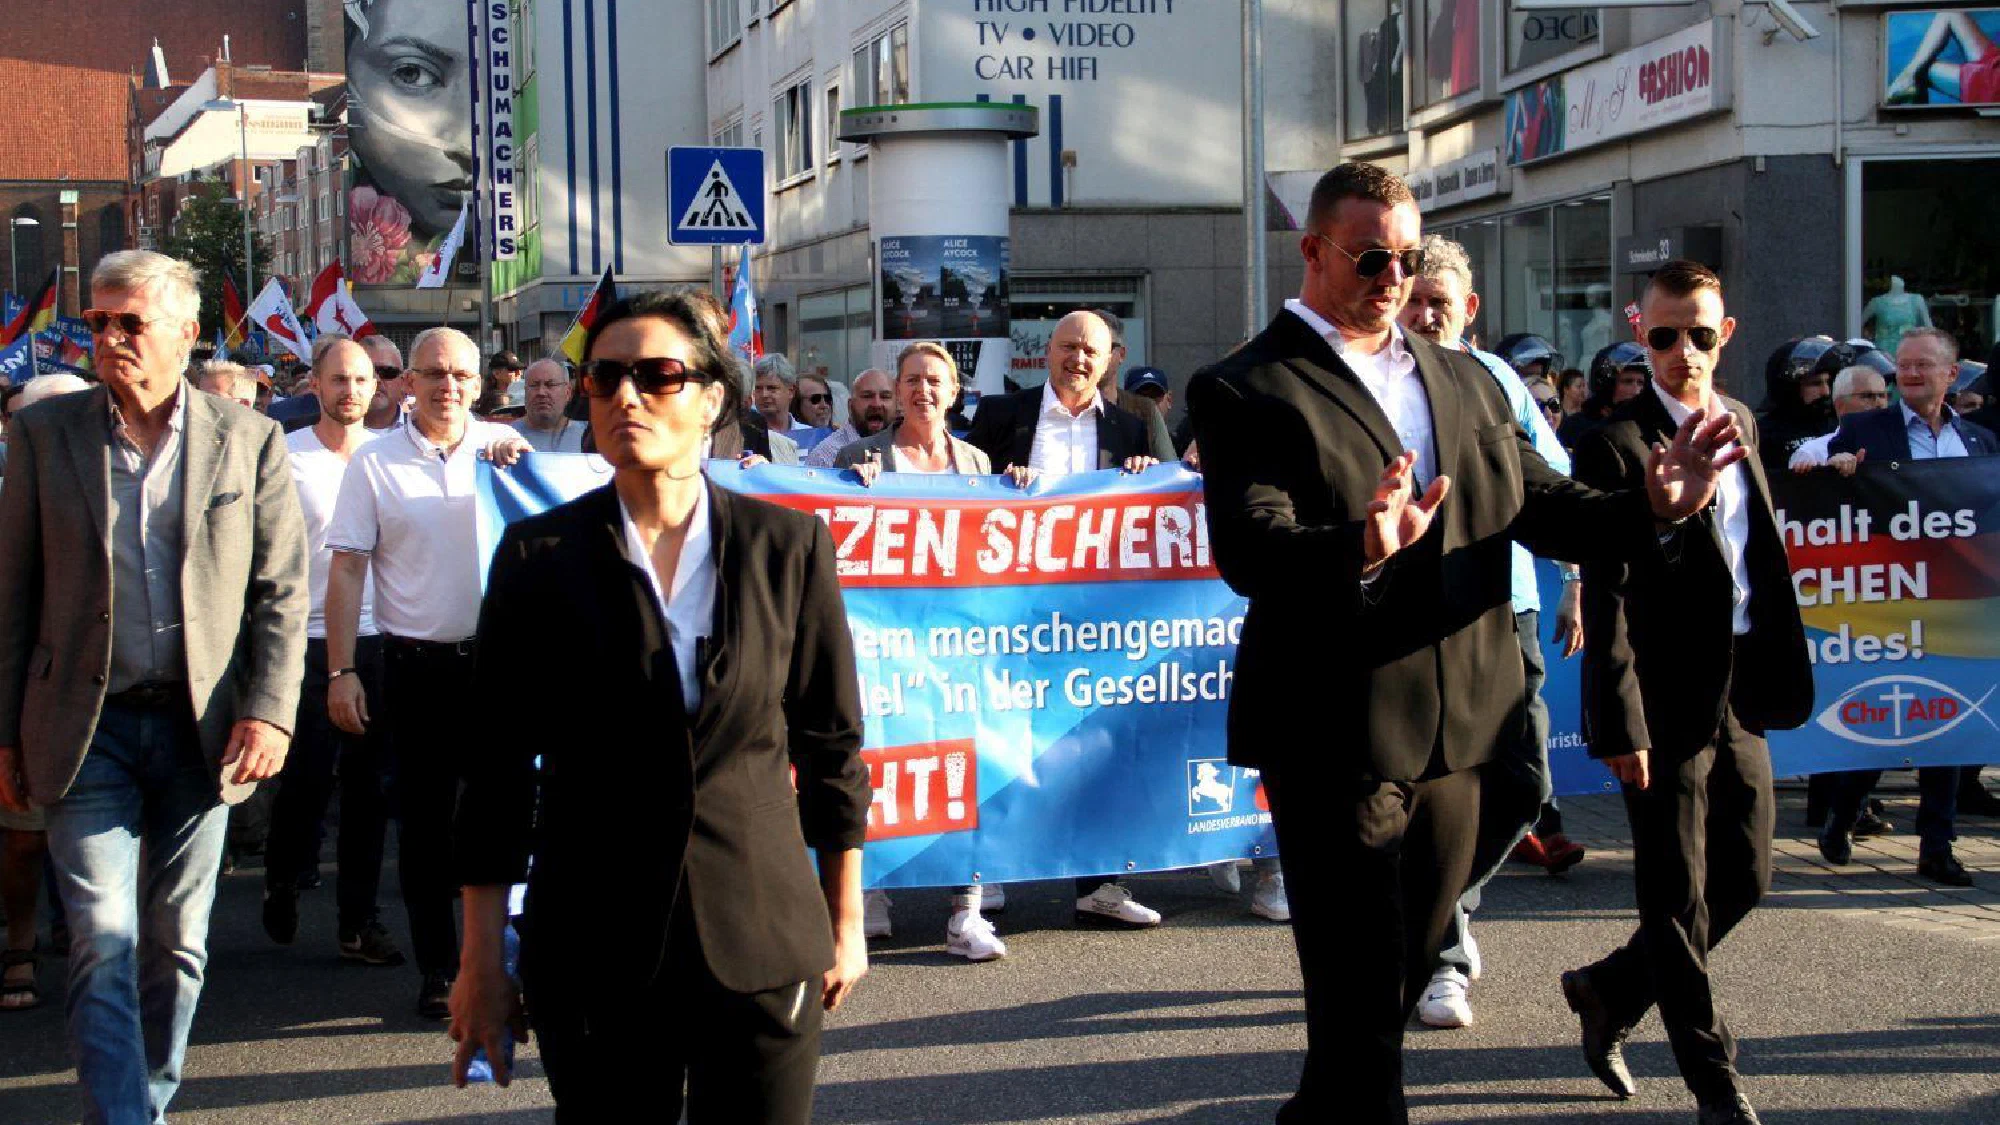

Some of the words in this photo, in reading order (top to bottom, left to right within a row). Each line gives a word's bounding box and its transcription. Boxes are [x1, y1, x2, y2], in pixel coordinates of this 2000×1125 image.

[976, 21, 1010, 46] TV
[1047, 23, 1136, 48] VIDEO
[975, 55, 1034, 80] CAR
[1047, 56, 1098, 81] HIFI
[1638, 43, 1710, 106] FASHION
[491, 2, 516, 256] SCHUMACHERS
[943, 239, 968, 248] ALICE
[943, 249, 978, 258] AYCOCK
[815, 505, 960, 577] ZEN
[1889, 500, 1978, 541] des
[1791, 560, 1928, 607] CHEN
[928, 604, 1249, 661] menschengemac
[941, 671, 978, 713] in
[988, 669, 1050, 712] der
[1187, 813, 1258, 835] LANDESVERBAND
